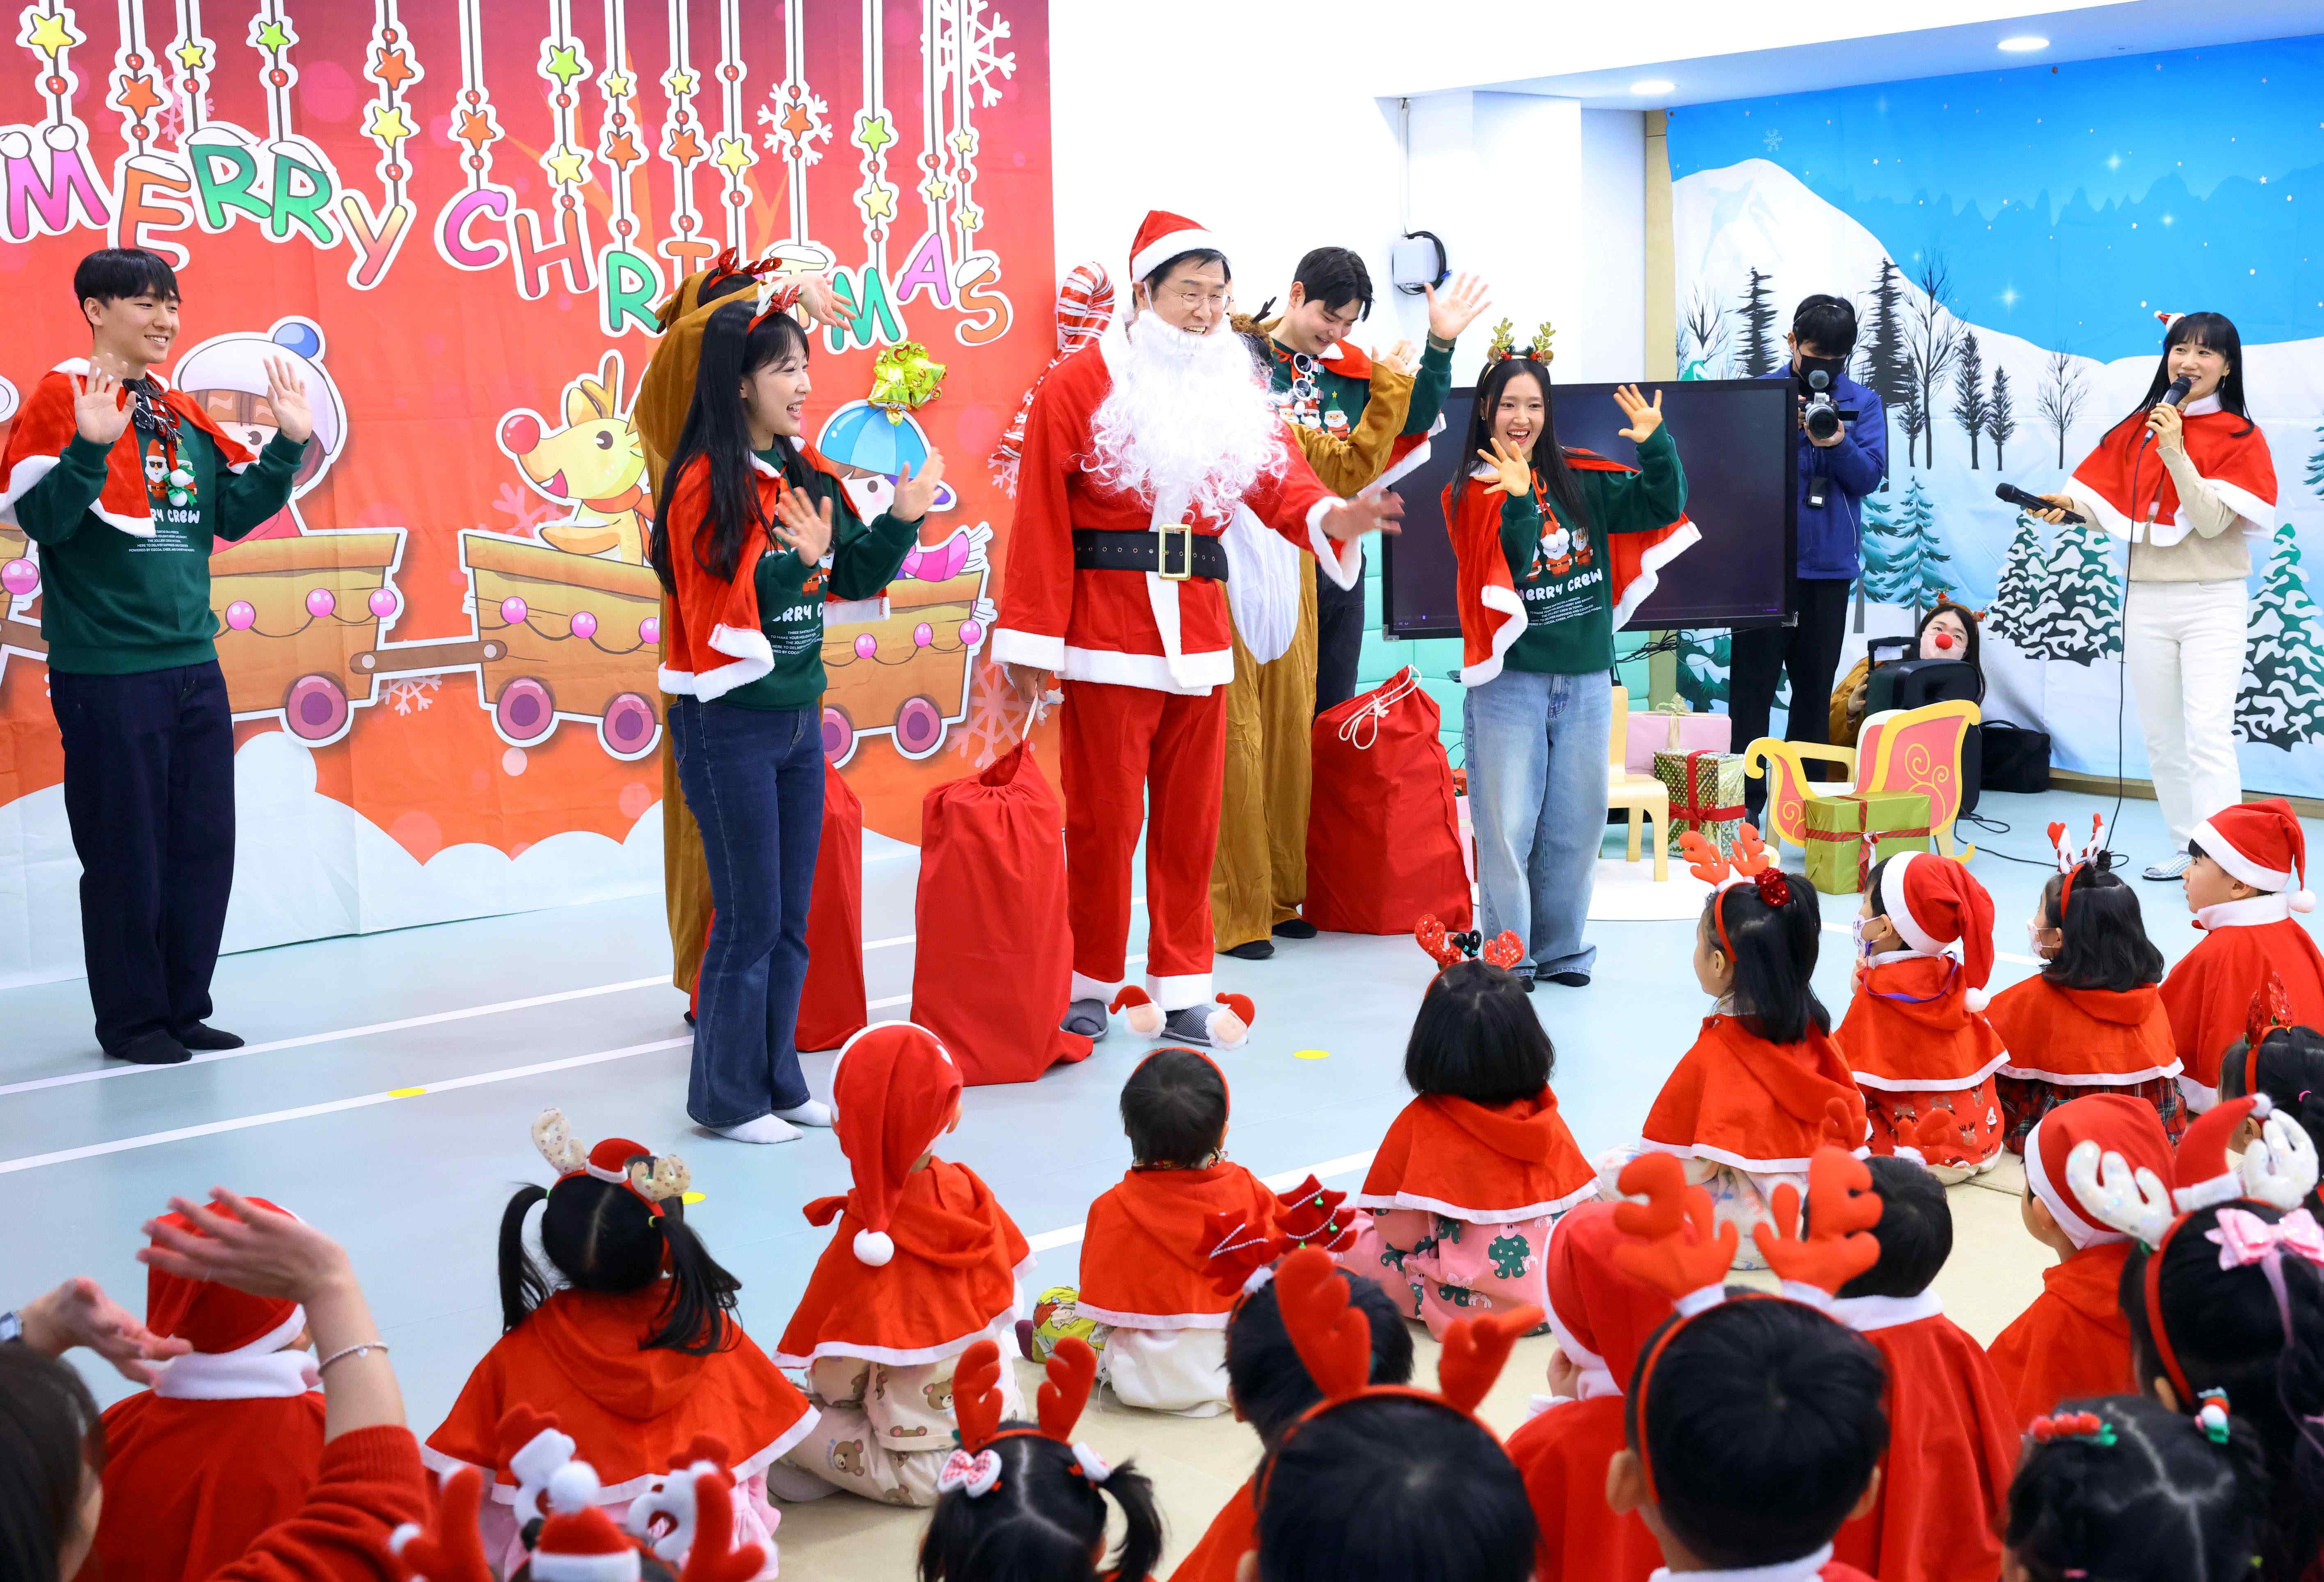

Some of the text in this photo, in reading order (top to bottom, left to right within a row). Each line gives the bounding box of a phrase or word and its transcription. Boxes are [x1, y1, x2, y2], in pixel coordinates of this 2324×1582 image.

[1, 124, 1008, 350] MERRY CHRTMAS
[772, 605, 812, 622] RRY
